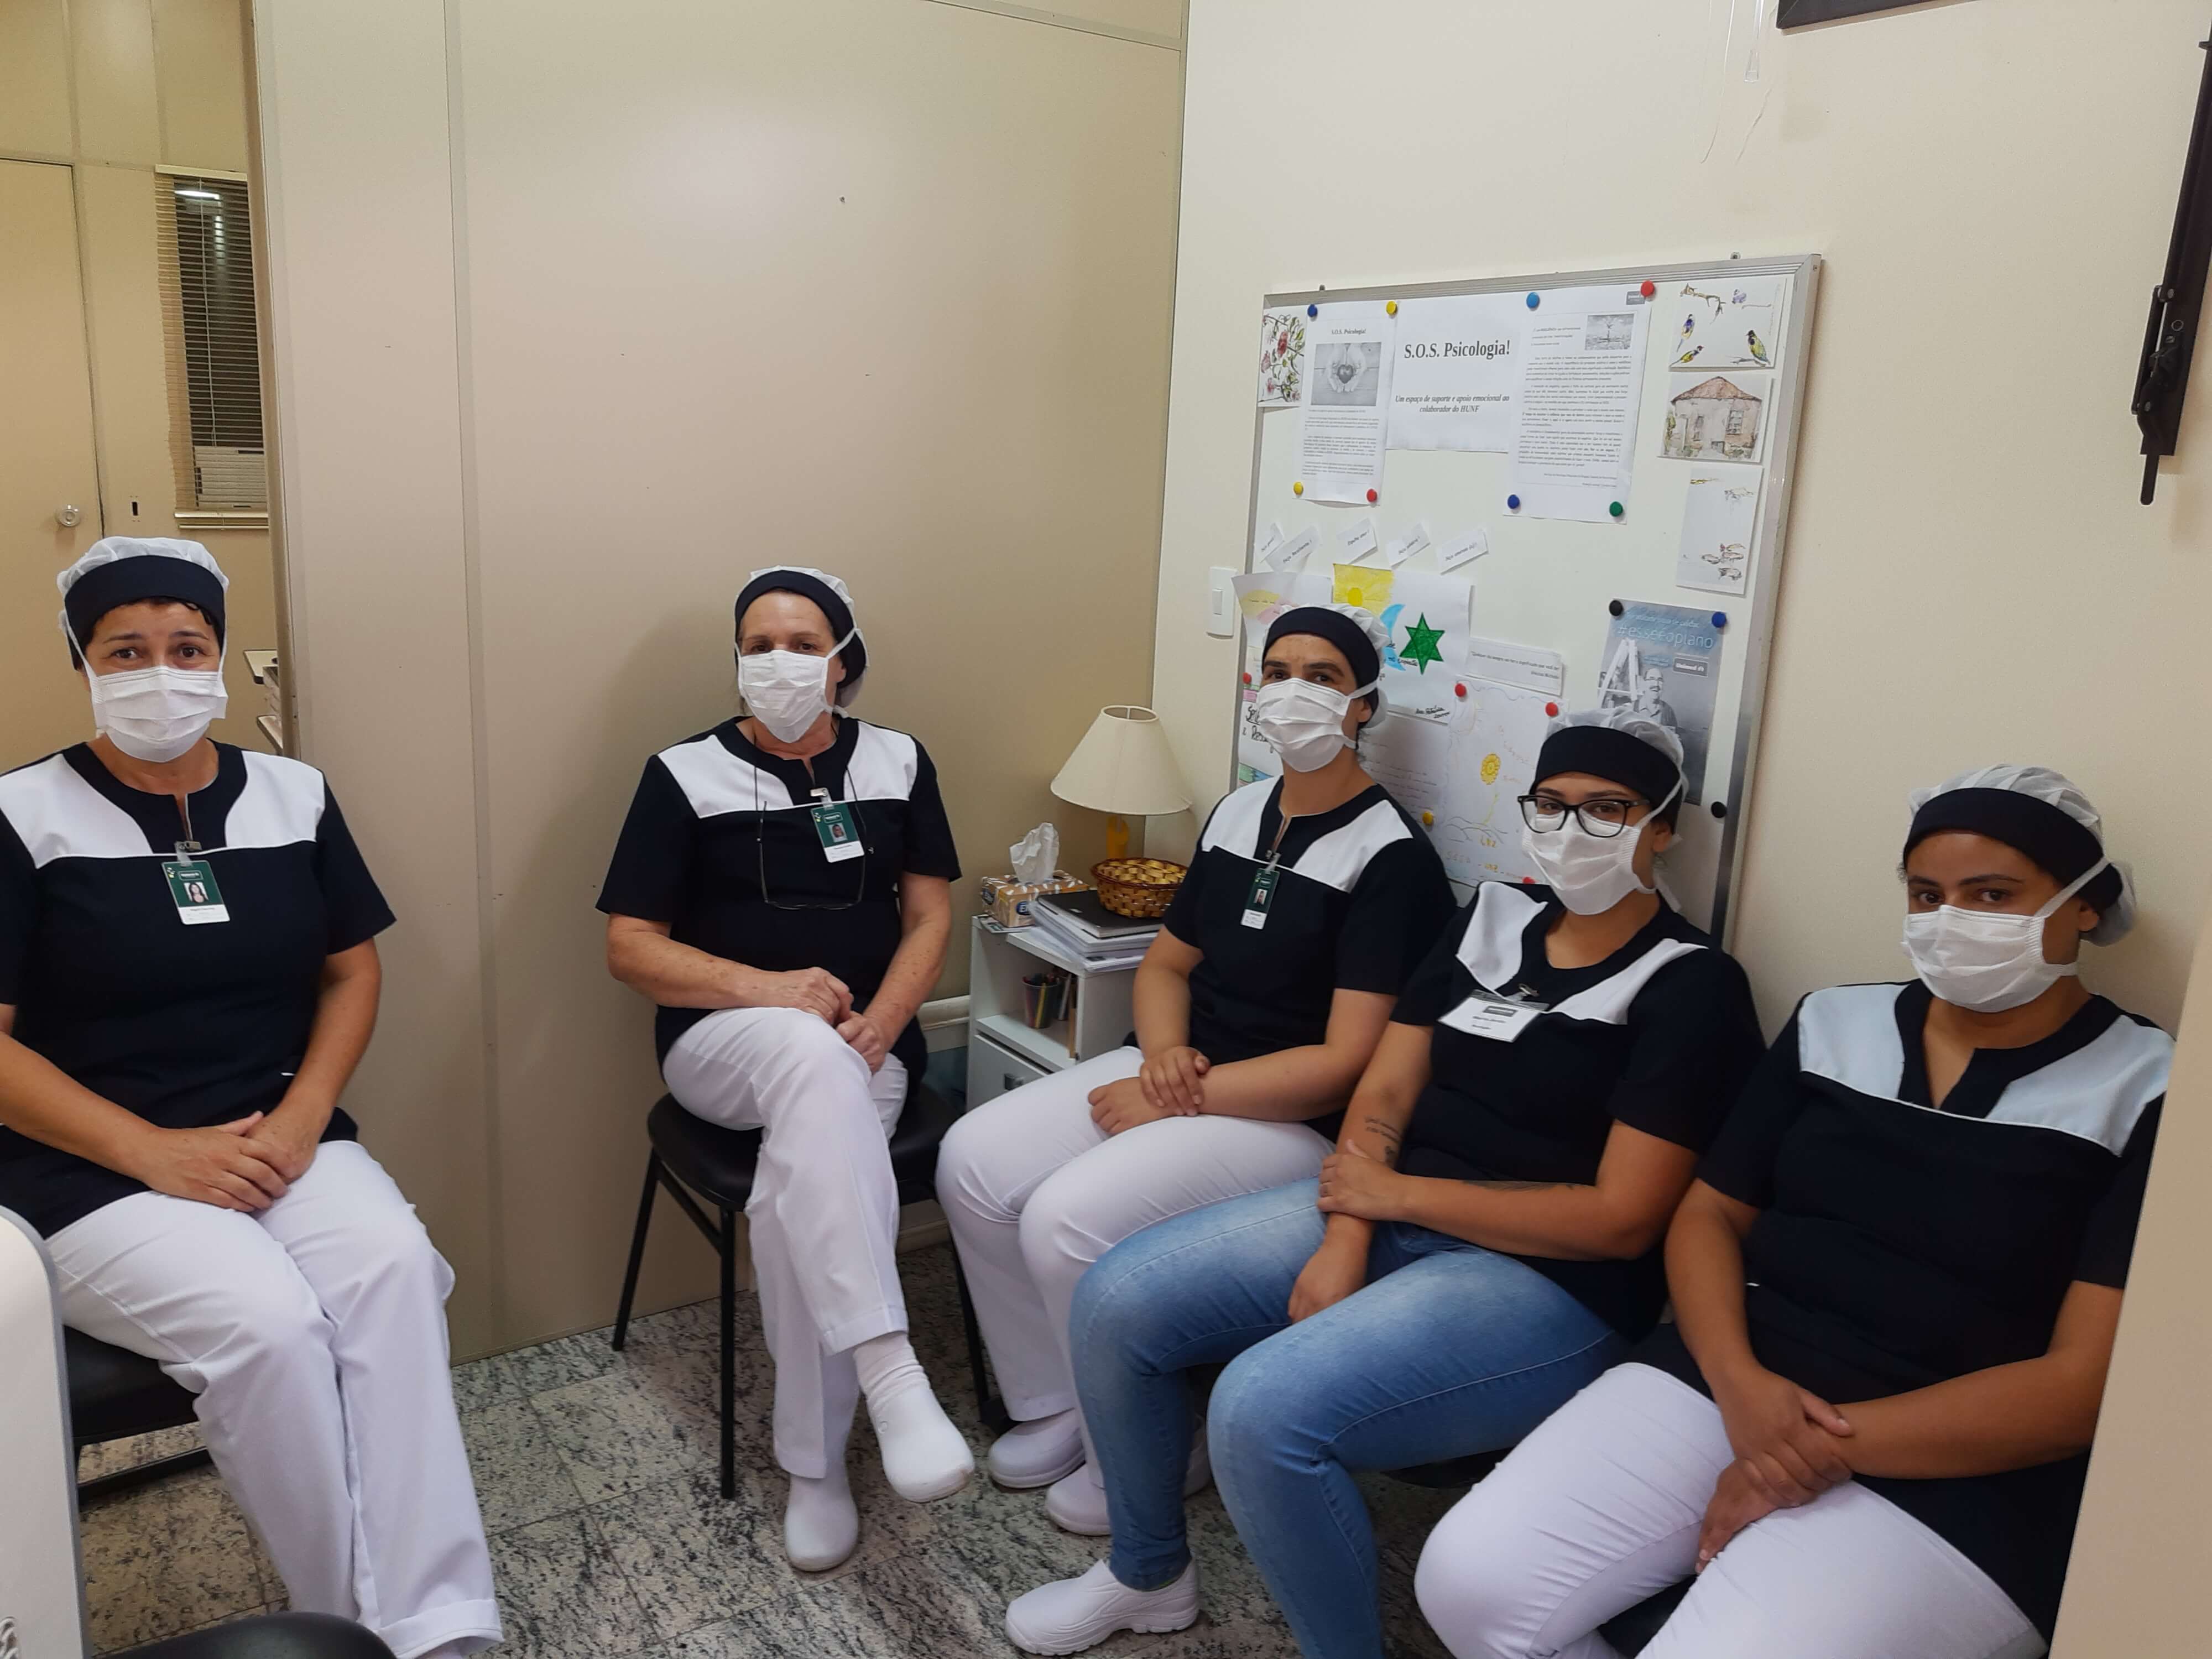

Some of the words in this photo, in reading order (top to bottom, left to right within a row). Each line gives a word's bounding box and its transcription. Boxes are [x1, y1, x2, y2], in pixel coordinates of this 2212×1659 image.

[1404, 343, 1439, 358] S.O.S.
[1443, 340, 1510, 360] Psicologia!
[1617, 623, 1714, 649] #esseéoplano
